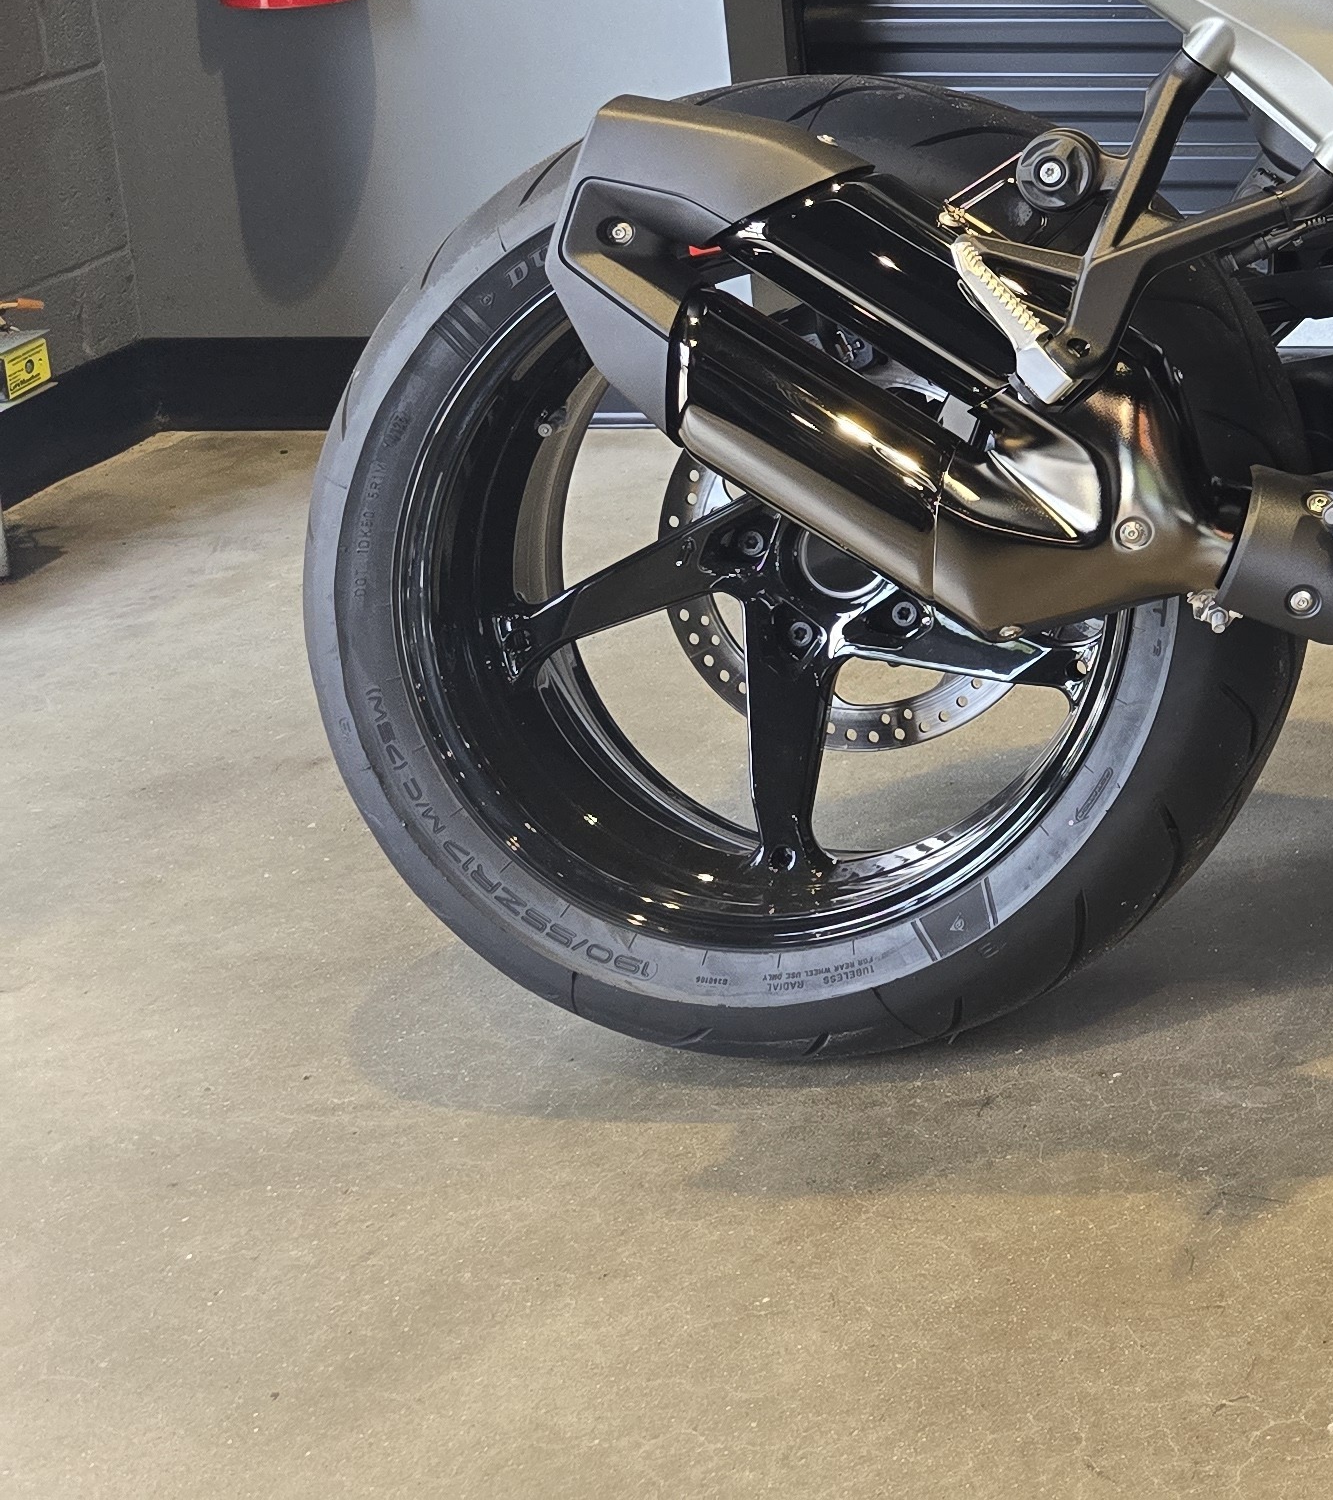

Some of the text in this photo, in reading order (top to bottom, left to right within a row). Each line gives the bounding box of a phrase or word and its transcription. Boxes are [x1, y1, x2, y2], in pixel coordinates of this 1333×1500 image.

[443, 839, 651, 978] 190/55ZR17
[805, 964, 833, 978] WHEEL
[833, 959, 856, 972] REAR
[762, 973, 783, 982] ONLY
[766, 964, 875, 992] TUBELESS RADIAL
[785, 970, 802, 979] USE
